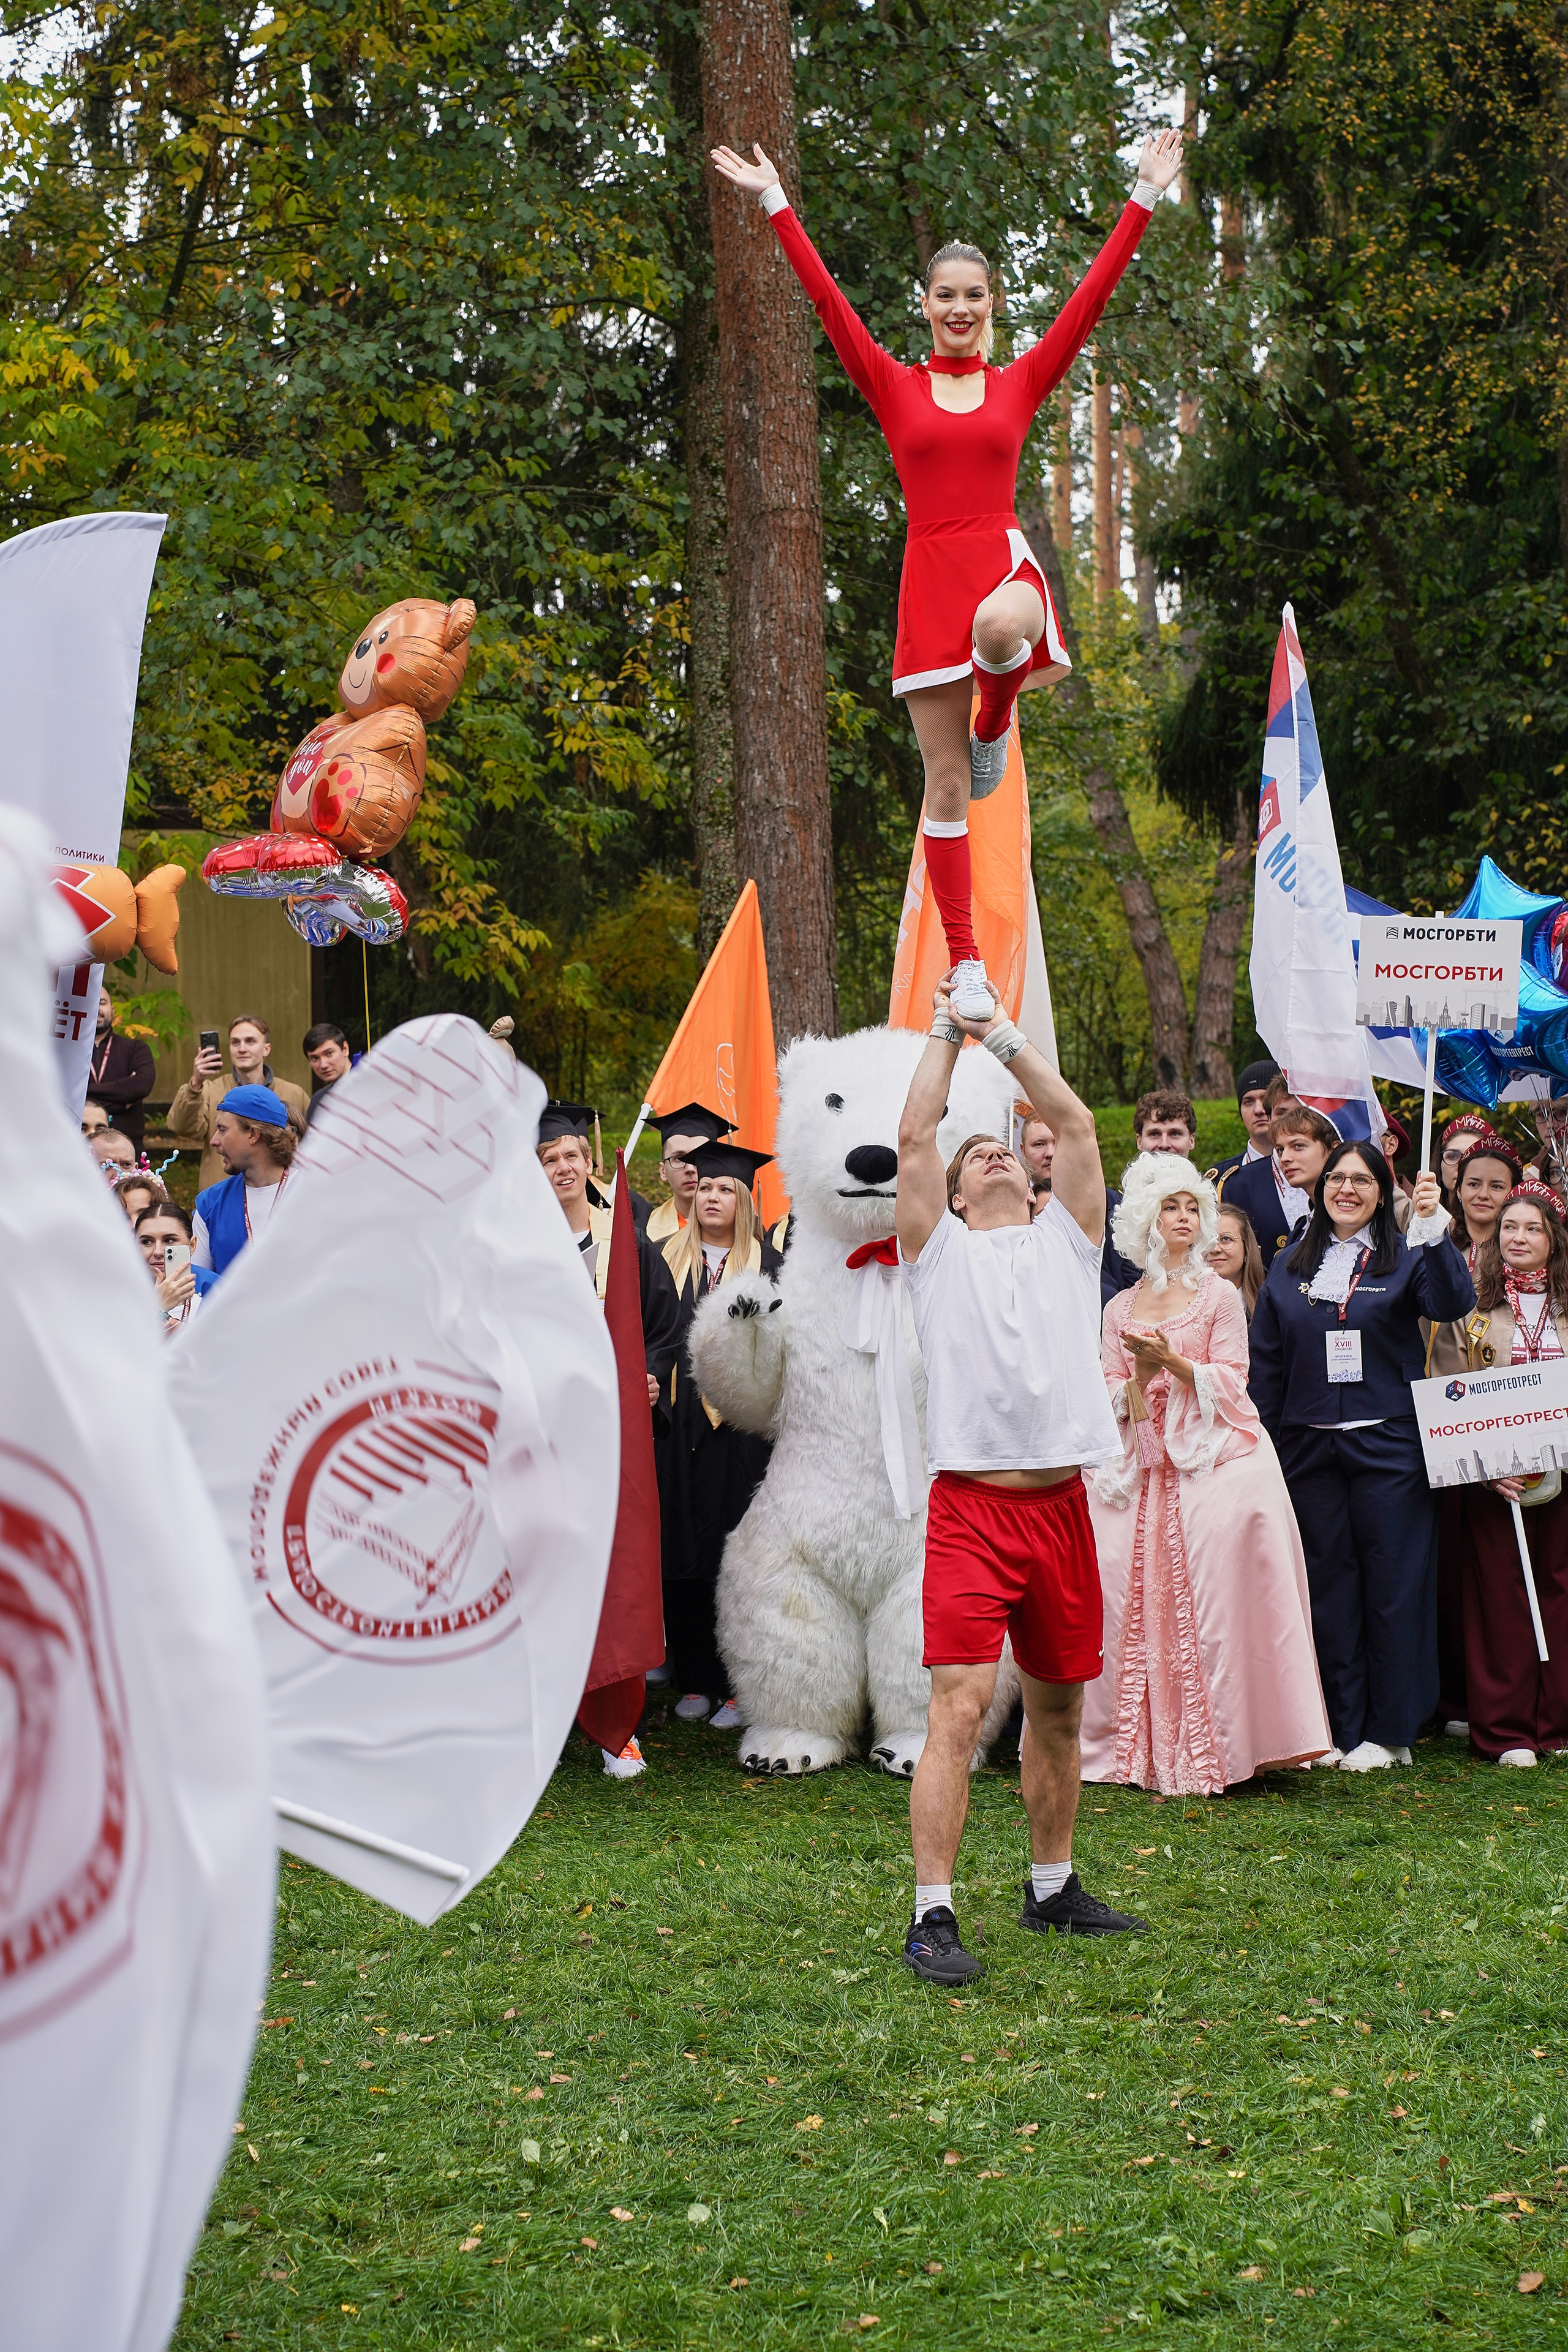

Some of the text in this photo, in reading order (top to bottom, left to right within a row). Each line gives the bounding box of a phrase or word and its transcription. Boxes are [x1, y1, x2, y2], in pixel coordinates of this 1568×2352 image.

[295, 737, 323, 758] love
[288, 758, 315, 783] you
[55, 846, 105, 862] ПОЛИТИКИ
[1403, 927, 1496, 942] МОСГОРБТИ
[1375, 964, 1503, 981] МОСГОРБТИ
[324, 1354, 400, 1399] СОВЕТ
[1468, 1373, 1542, 1395] МОСГОРГЕОТРЕСТ
